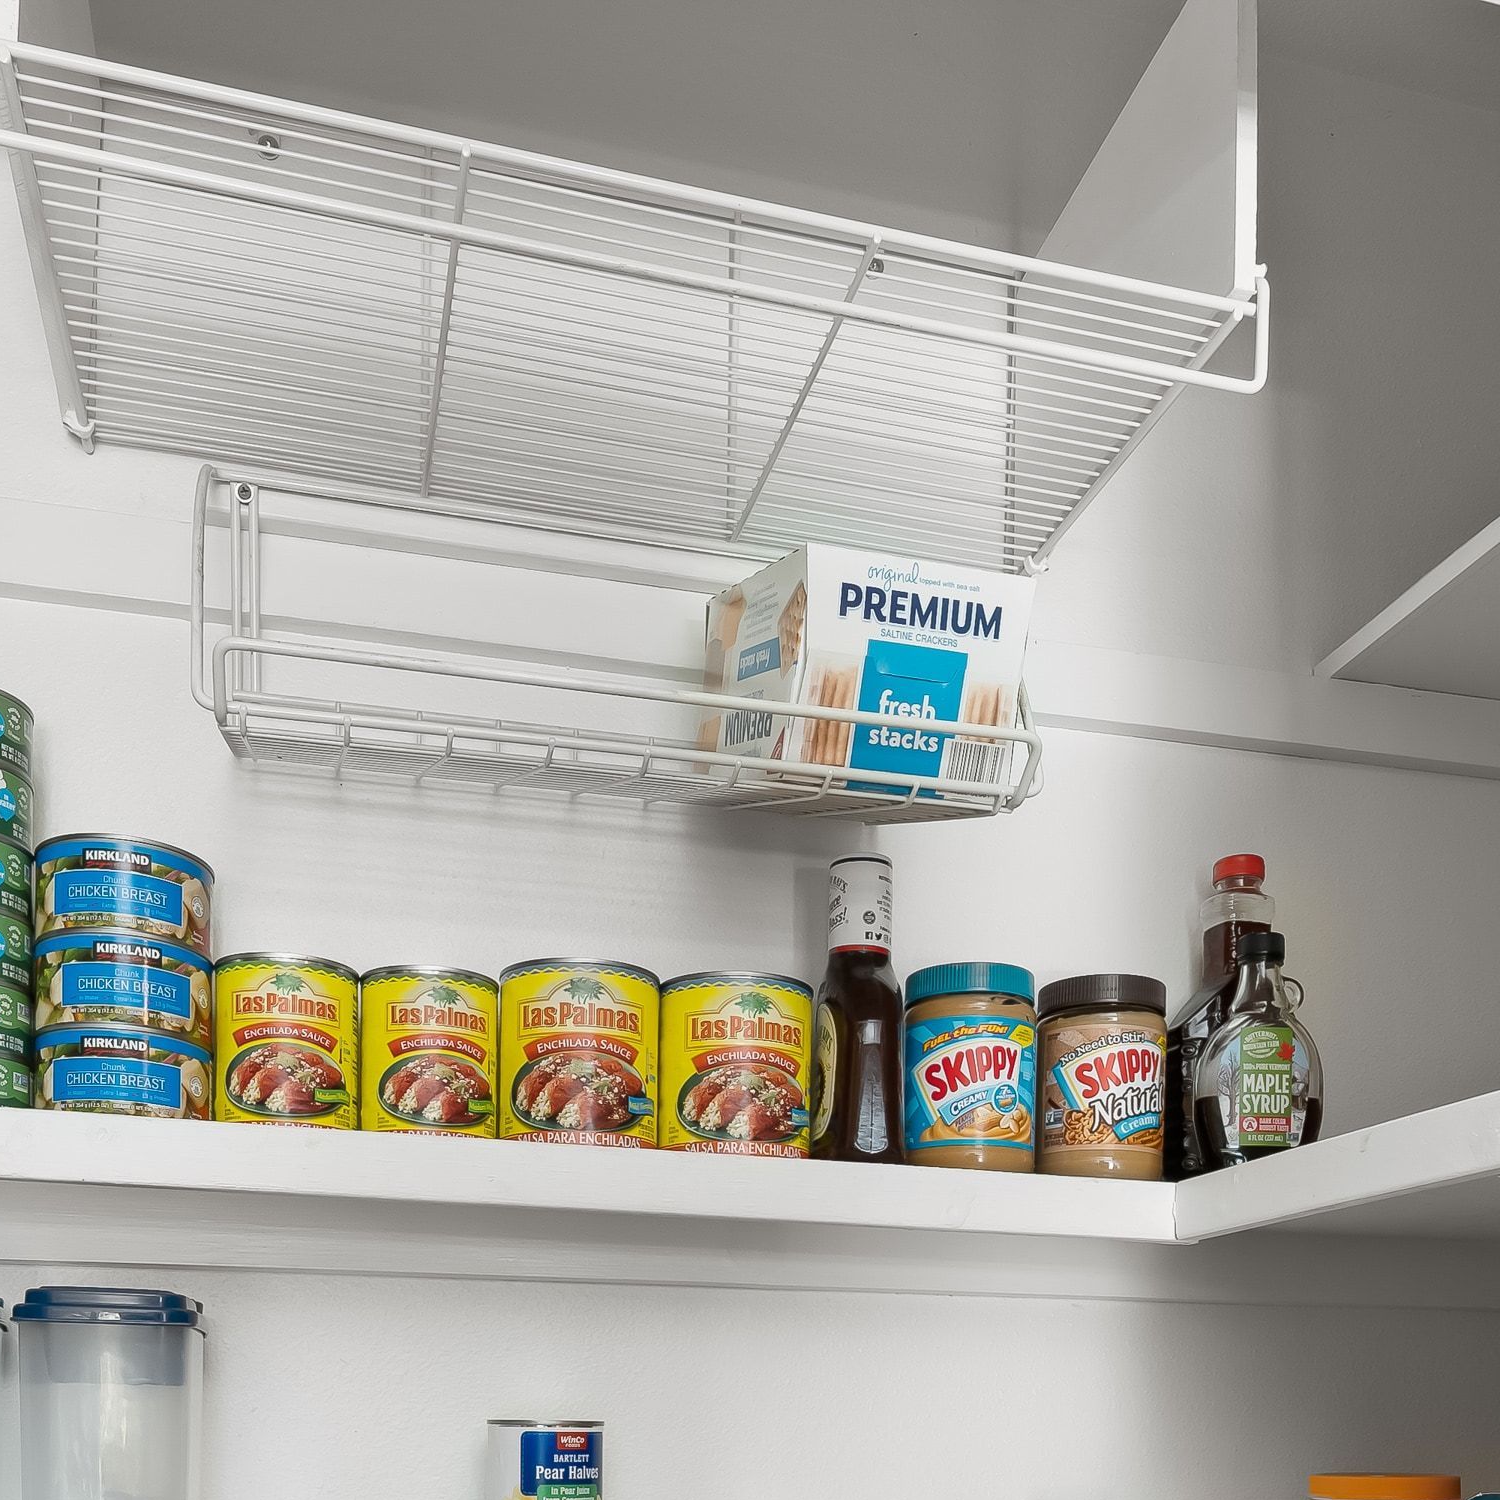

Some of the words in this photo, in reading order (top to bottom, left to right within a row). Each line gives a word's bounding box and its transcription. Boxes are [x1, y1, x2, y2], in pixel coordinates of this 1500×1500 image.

[867, 562, 920, 592] original
[919, 577, 940, 586] topped
[942, 579, 954, 587] with
[838, 582, 1003, 640] PREMIUM
[881, 628, 912, 642] SALTINE
[915, 633, 958, 647] CRACKERS
[878, 690, 936, 720] fresh
[868, 727, 939, 752] stacks
[86, 850, 149, 865] KIRKLAND
[103, 876, 128, 884] Chunk
[69, 886, 117, 897] CHICKEN
[121, 888, 167, 906] BREAST
[244, 1027, 299, 1040] ENCHILADA
[301, 1029, 331, 1047] SAUCE
[923, 1033, 952, 1052] FUEL
[953, 1027, 977, 1038] the
[979, 1024, 1009, 1033] FUN!
[536, 1038, 598, 1053] ENCHILADA
[600, 1040, 631, 1059] SAUCE
[1060, 1052, 1076, 1066] No
[1076, 1037, 1106, 1054] Need
[1108, 1035, 1120, 1044] to
[1122, 1032, 1145, 1042] Stir!
[925, 1046, 1017, 1101] SKIPPY
[1075, 1048, 1159, 1098] SKIPPY
[1243, 1074, 1289, 1093] MAPLE
[951, 1091, 988, 1116] CREAMY
[1090, 1082, 1163, 1132] Natural
[1243, 1095, 1289, 1114] SYRUP
[1121, 1115, 1156, 1133] Creamy
[547, 1132, 576, 1144] PARA
[560, 1435, 584, 1444] WinCo
[536, 1466, 564, 1479] Pear
[569, 1466, 598, 1479] Halves
